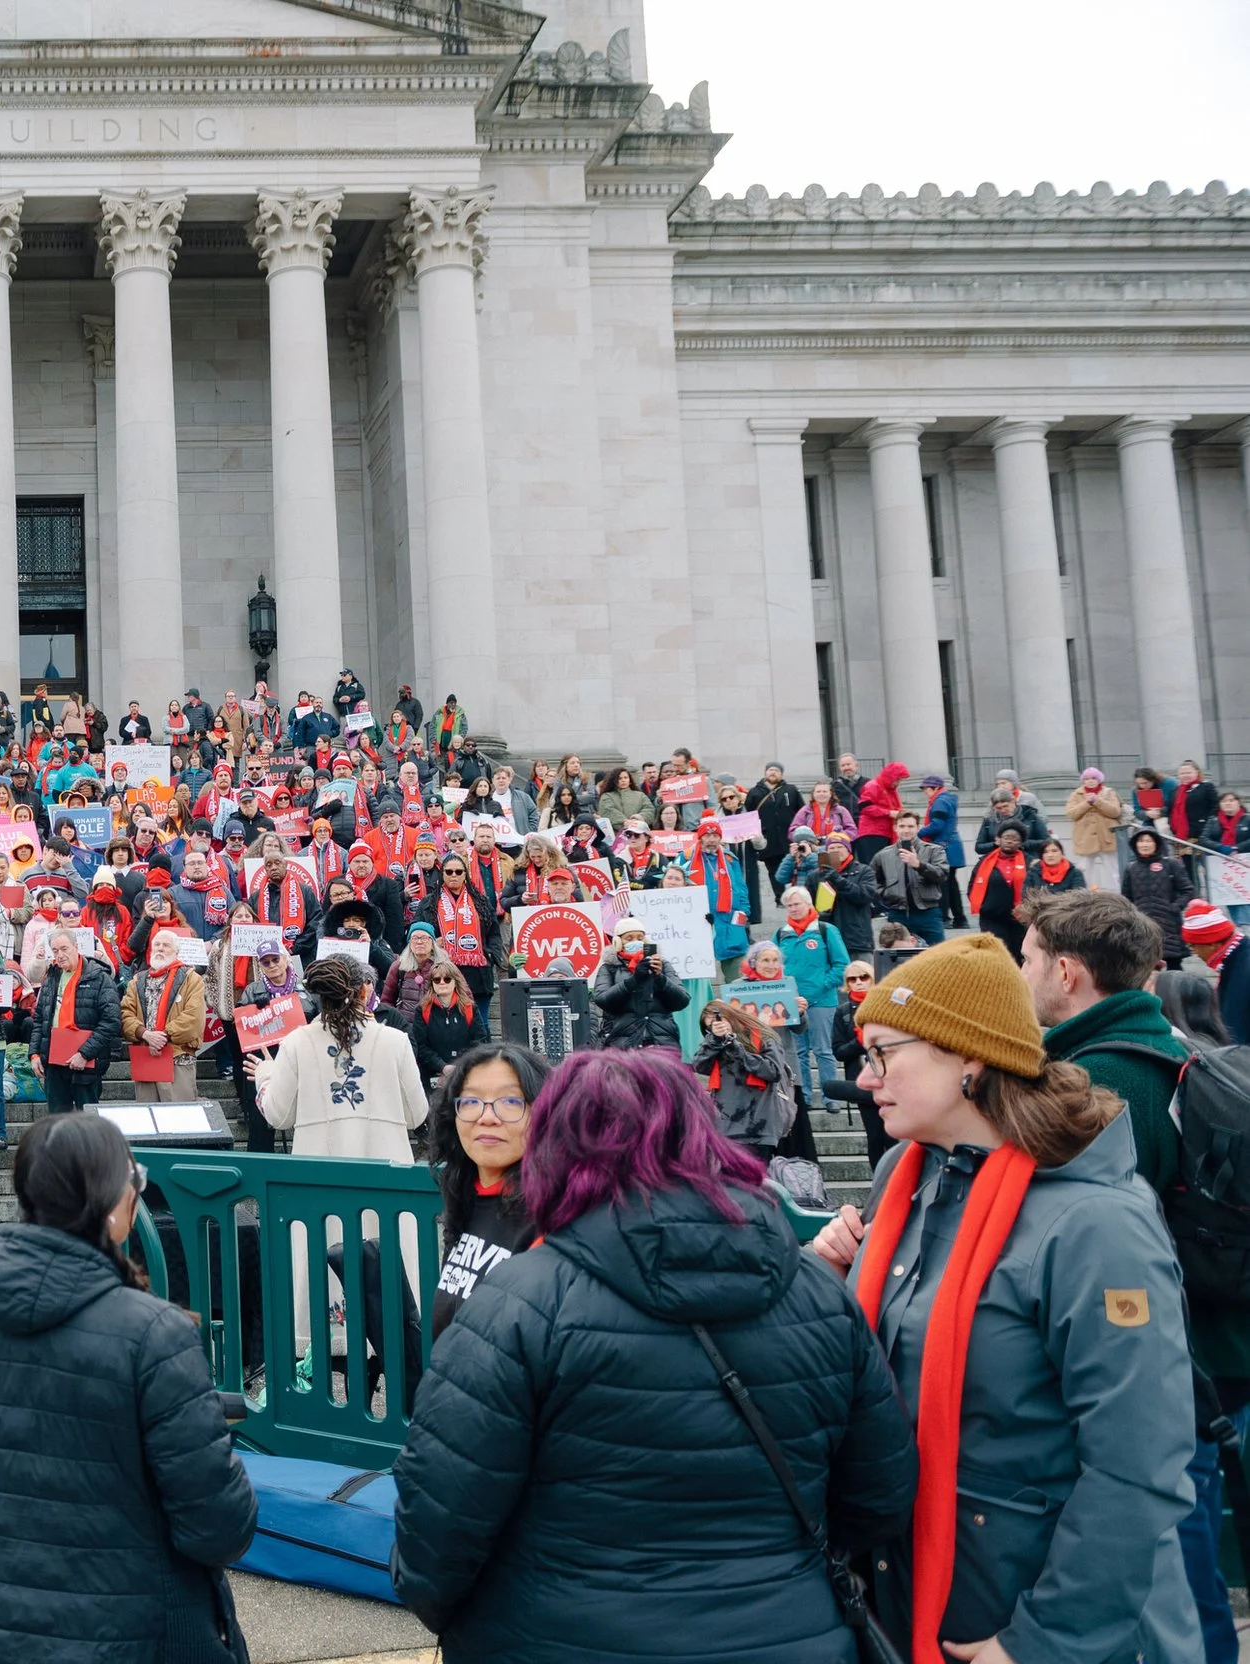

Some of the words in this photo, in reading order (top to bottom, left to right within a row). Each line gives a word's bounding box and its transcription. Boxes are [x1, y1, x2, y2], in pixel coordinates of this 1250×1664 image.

[270, 756, 294, 766] FUND
[136, 788, 157, 801] LAS
[470, 822, 510, 834] FND
[581, 867, 611, 892] EDUCATIO
[637, 894, 693, 916] Yearning
[521, 910, 560, 958] WASHINGTON
[563, 911, 598, 955] EDUCATION
[646, 924, 692, 940] eathe
[532, 936, 588, 958] WEA
[242, 1007, 273, 1030] People
[272, 998, 294, 1016] over
[258, 1015, 286, 1038] Profit
[448, 1232, 512, 1276] ERV
[438, 1264, 478, 1300] EOPL
